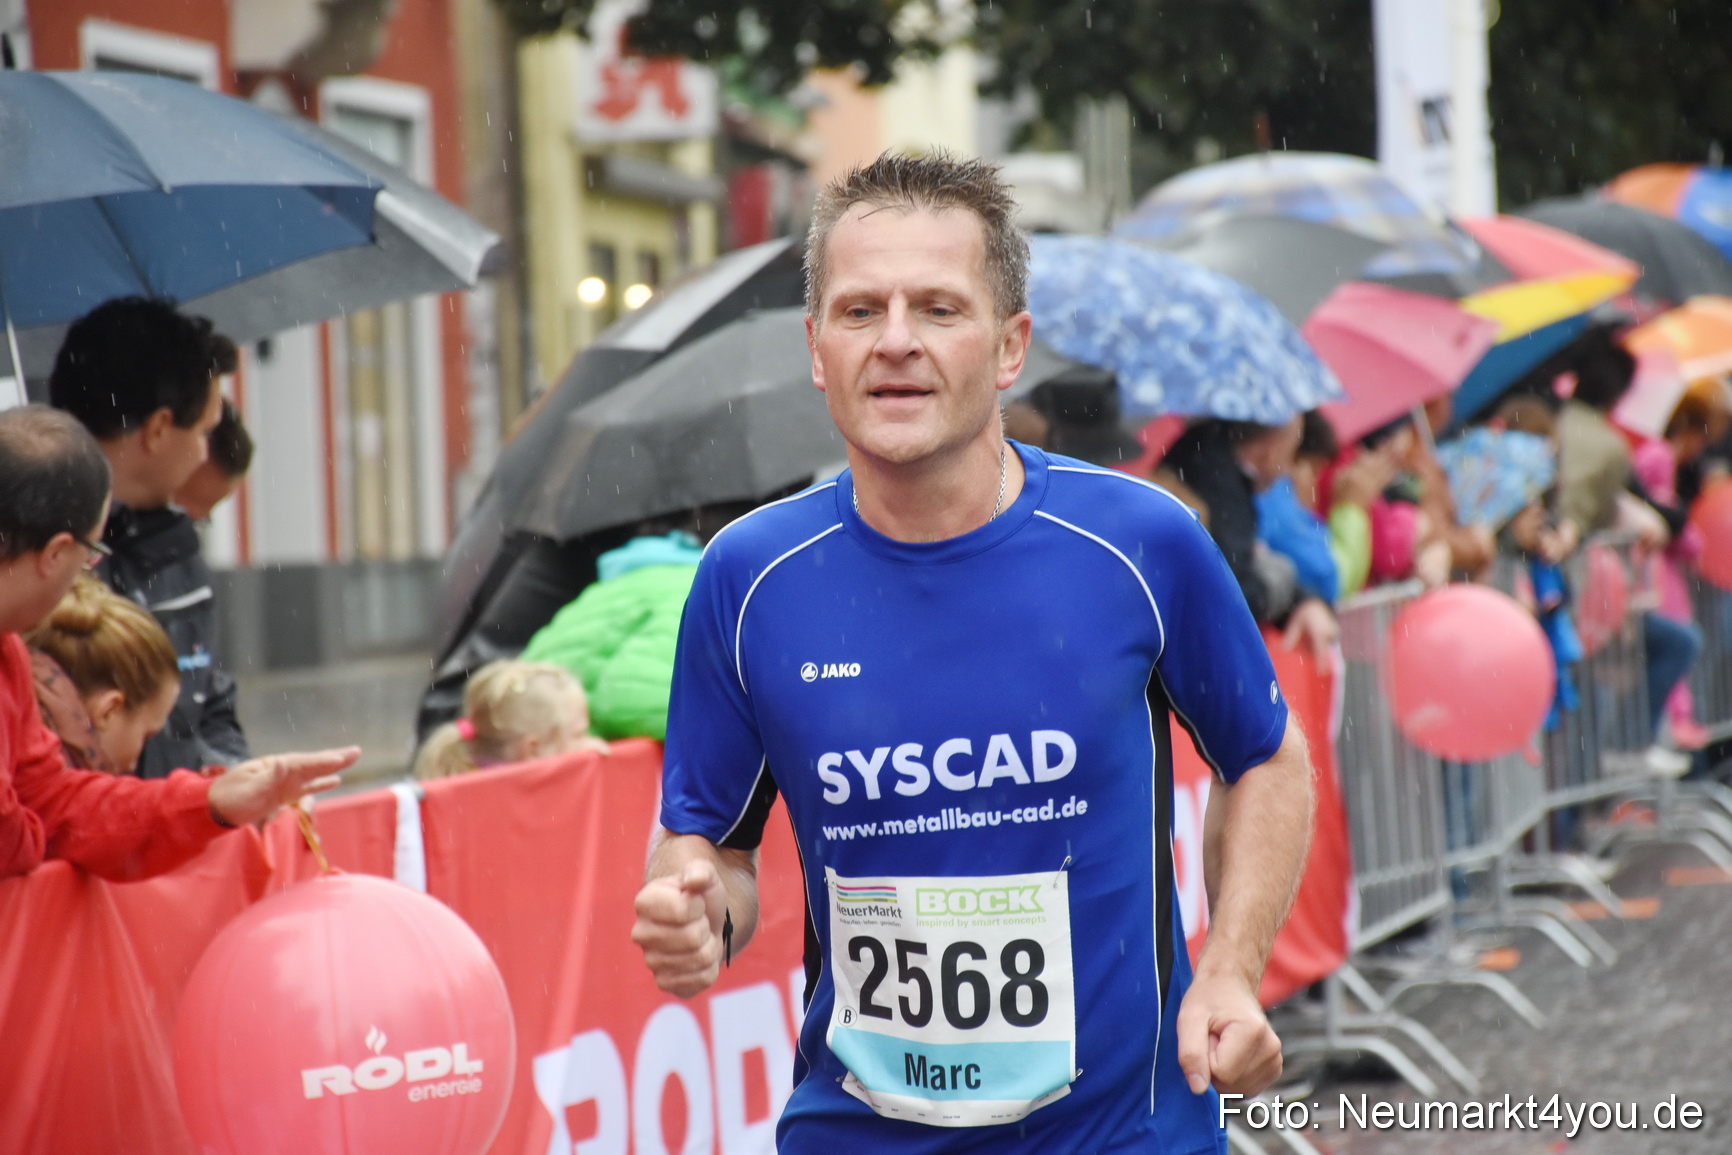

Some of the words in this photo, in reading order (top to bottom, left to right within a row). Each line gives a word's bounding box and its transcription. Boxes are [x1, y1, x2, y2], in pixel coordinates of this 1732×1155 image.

[821, 663, 861, 678] JAKO
[817, 730, 1077, 805] SYSCAD
[823, 795, 1088, 841] www.metallbau-cad.de
[916, 885, 1044, 916] BOCK
[916, 917, 956, 928] inspired
[957, 918, 969, 928] by
[971, 917, 1000, 927] smart
[1003, 916, 1046, 927] concepts
[848, 935, 1049, 1030] 2568
[408, 1076, 483, 1102] energie
[904, 1052, 982, 1091] Marc
